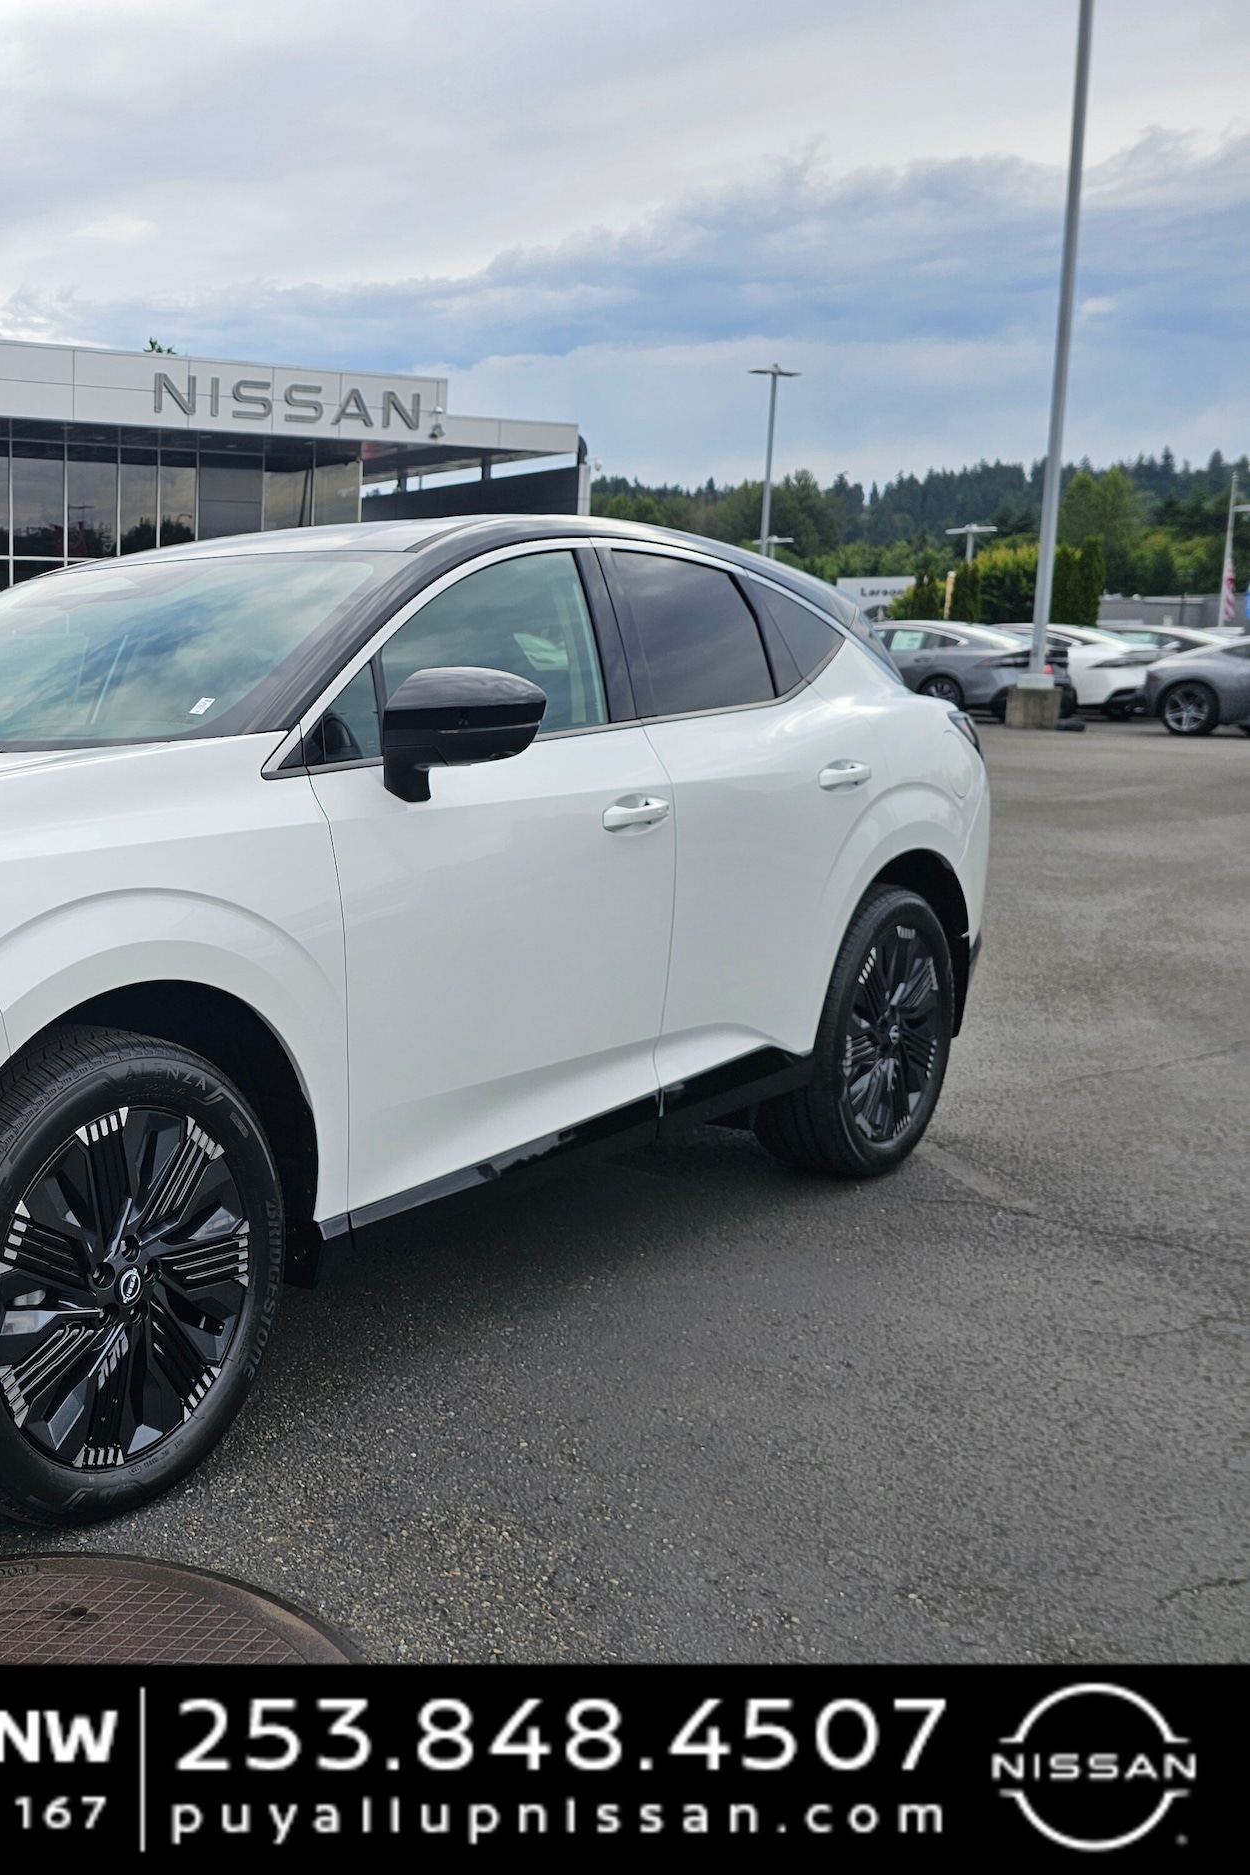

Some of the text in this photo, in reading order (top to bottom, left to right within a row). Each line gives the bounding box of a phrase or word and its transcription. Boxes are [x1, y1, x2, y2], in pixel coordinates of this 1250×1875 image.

[154, 372, 422, 430] NISSAN
[126, 1062, 206, 1091] ALENZA
[243, 1199, 282, 1379] BRIDGESTONE
